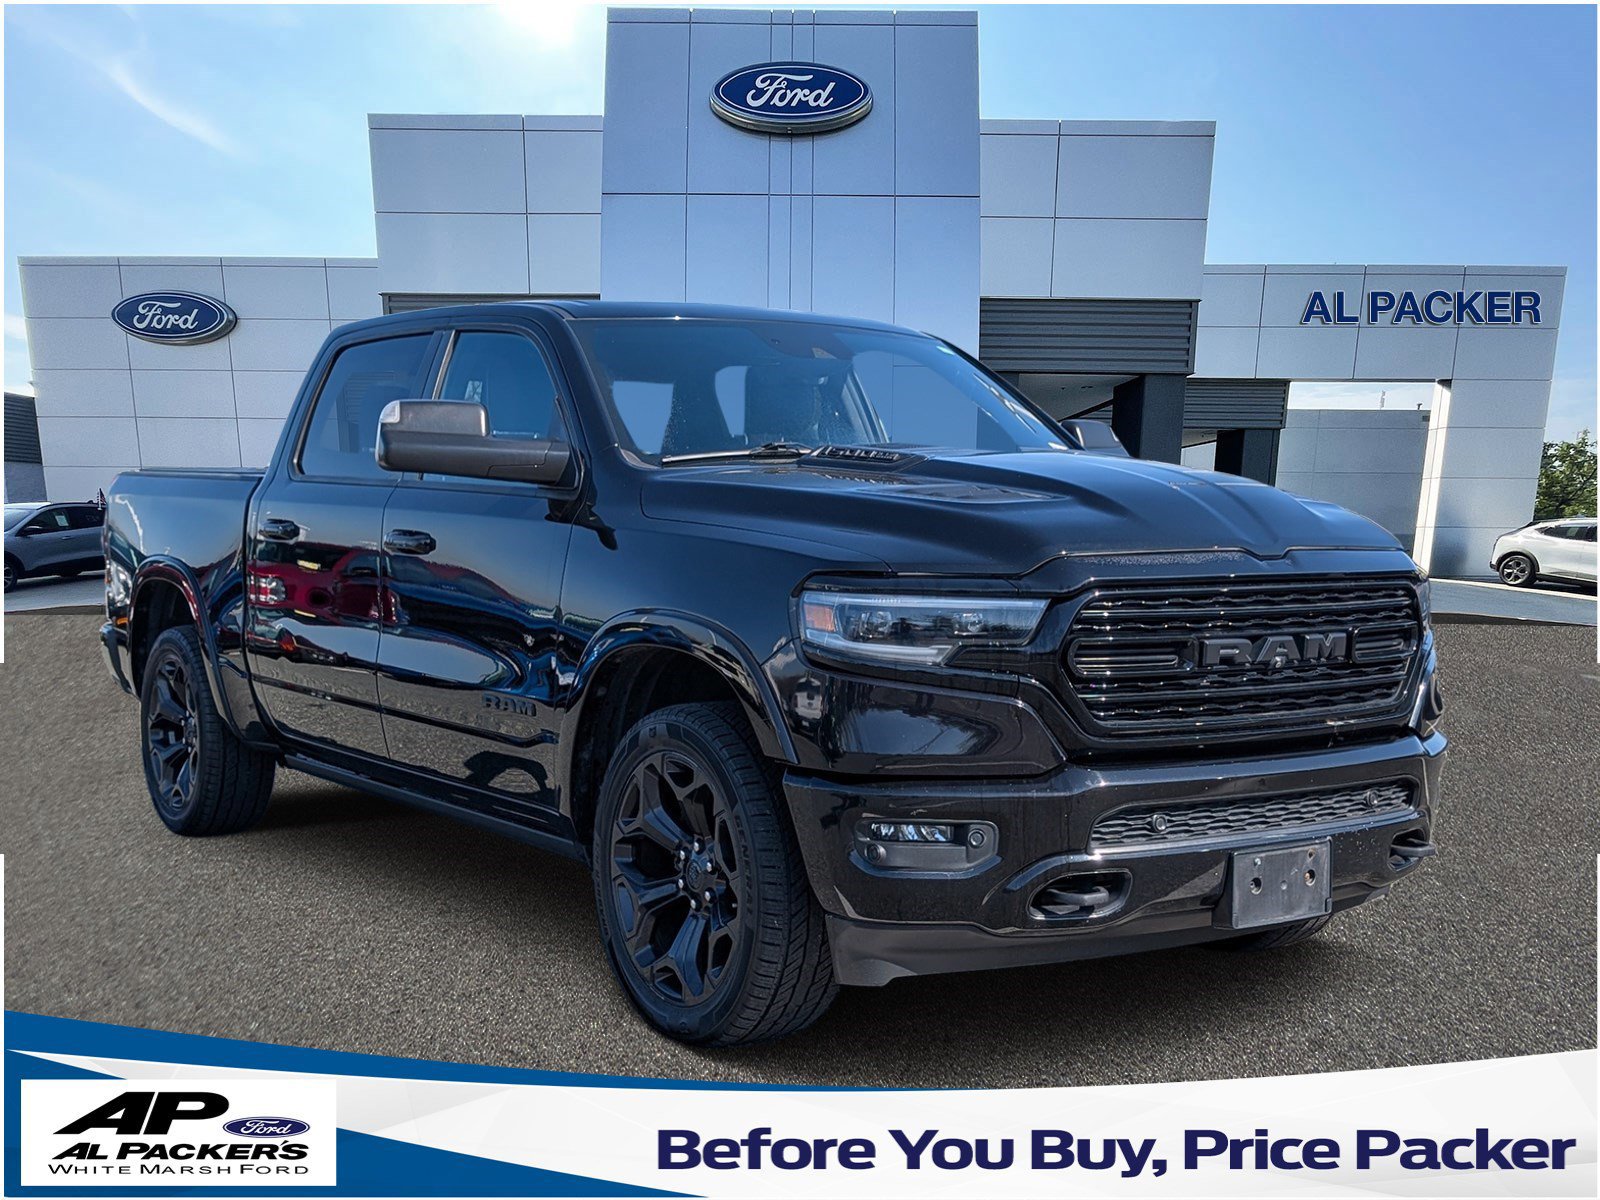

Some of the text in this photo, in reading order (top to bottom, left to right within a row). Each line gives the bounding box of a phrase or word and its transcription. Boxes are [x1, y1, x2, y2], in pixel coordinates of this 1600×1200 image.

[746, 73, 836, 107] Ford
[133, 301, 198, 329] Ford
[1302, 290, 1542, 325] AL PACKER
[1202, 632, 1348, 668] RAM
[482, 692, 538, 717] RAM
